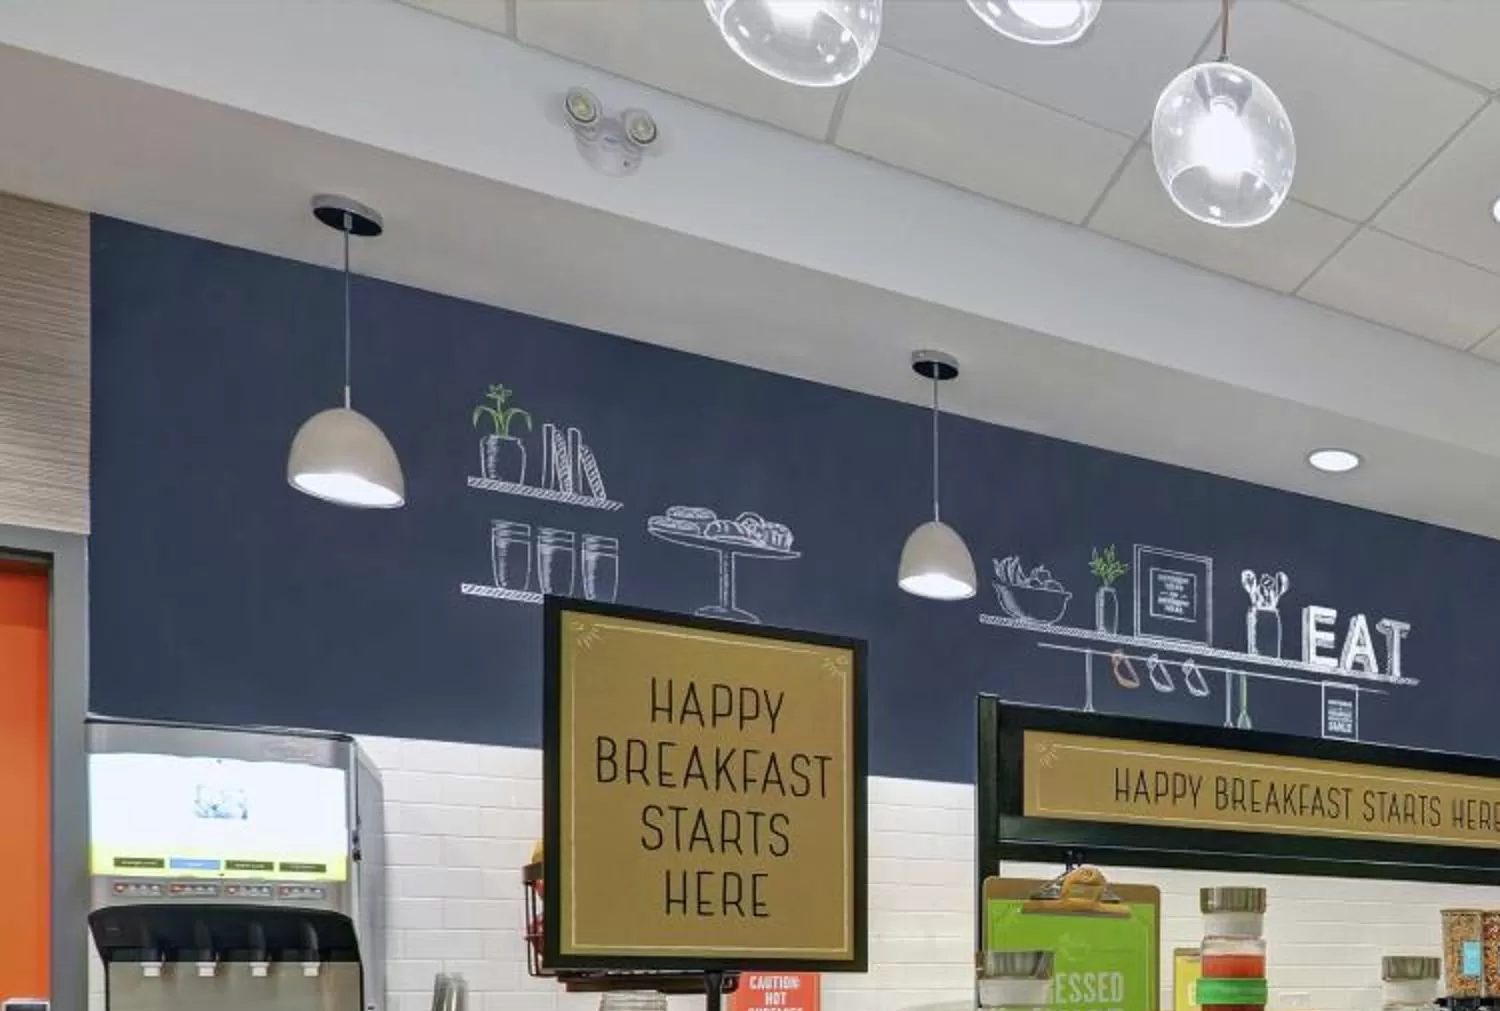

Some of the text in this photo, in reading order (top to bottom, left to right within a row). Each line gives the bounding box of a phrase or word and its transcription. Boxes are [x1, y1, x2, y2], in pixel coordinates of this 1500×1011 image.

[1302, 605, 1410, 678] EAT
[650, 676, 785, 734] HAPPY
[596, 735, 833, 799] BREAKFAST
[1114, 767, 1203, 810] HAPPY
[1215, 776, 1354, 821] BREAKFAST
[1363, 790, 1442, 828] STARTS
[640, 804, 790, 858] STARTS
[665, 869, 772, 918] HERE
[765, 991, 788, 1006] HOT
[1049, 971, 1125, 1004] ESSED
